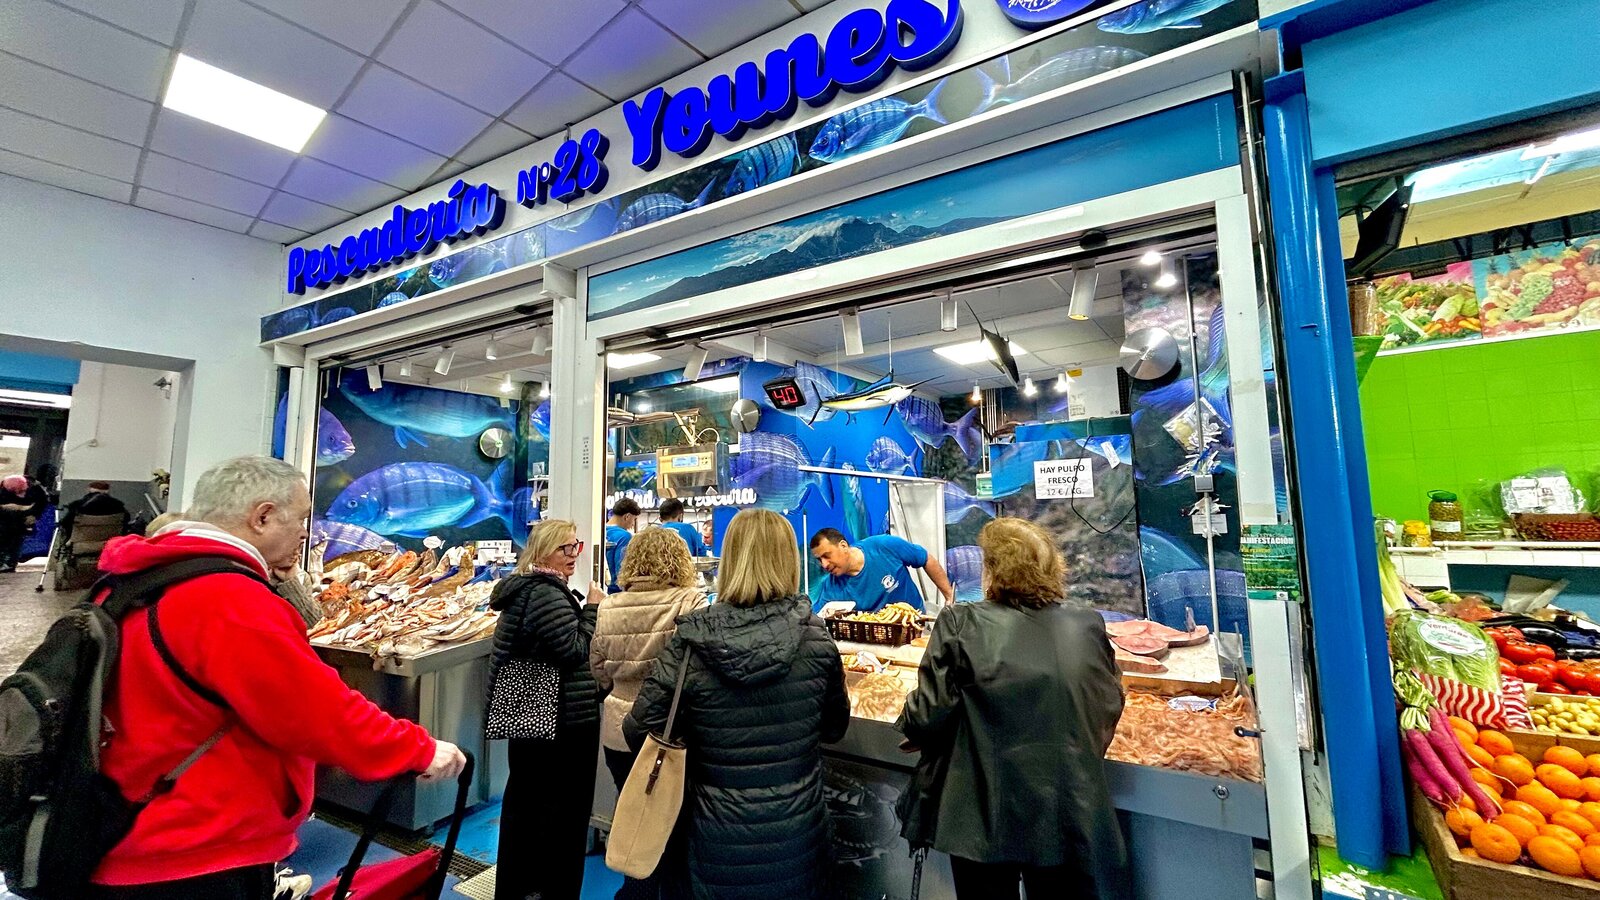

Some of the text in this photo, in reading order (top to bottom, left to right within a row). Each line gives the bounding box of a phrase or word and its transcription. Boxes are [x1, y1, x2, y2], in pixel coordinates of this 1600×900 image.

[287, 178, 502, 294] Pescadería
[622, 0, 963, 169] Younes
[1040, 464, 1085, 474] HAY PULPO
[1048, 476, 1078, 484] FRESCO
[1047, 488, 1056, 496] 12
